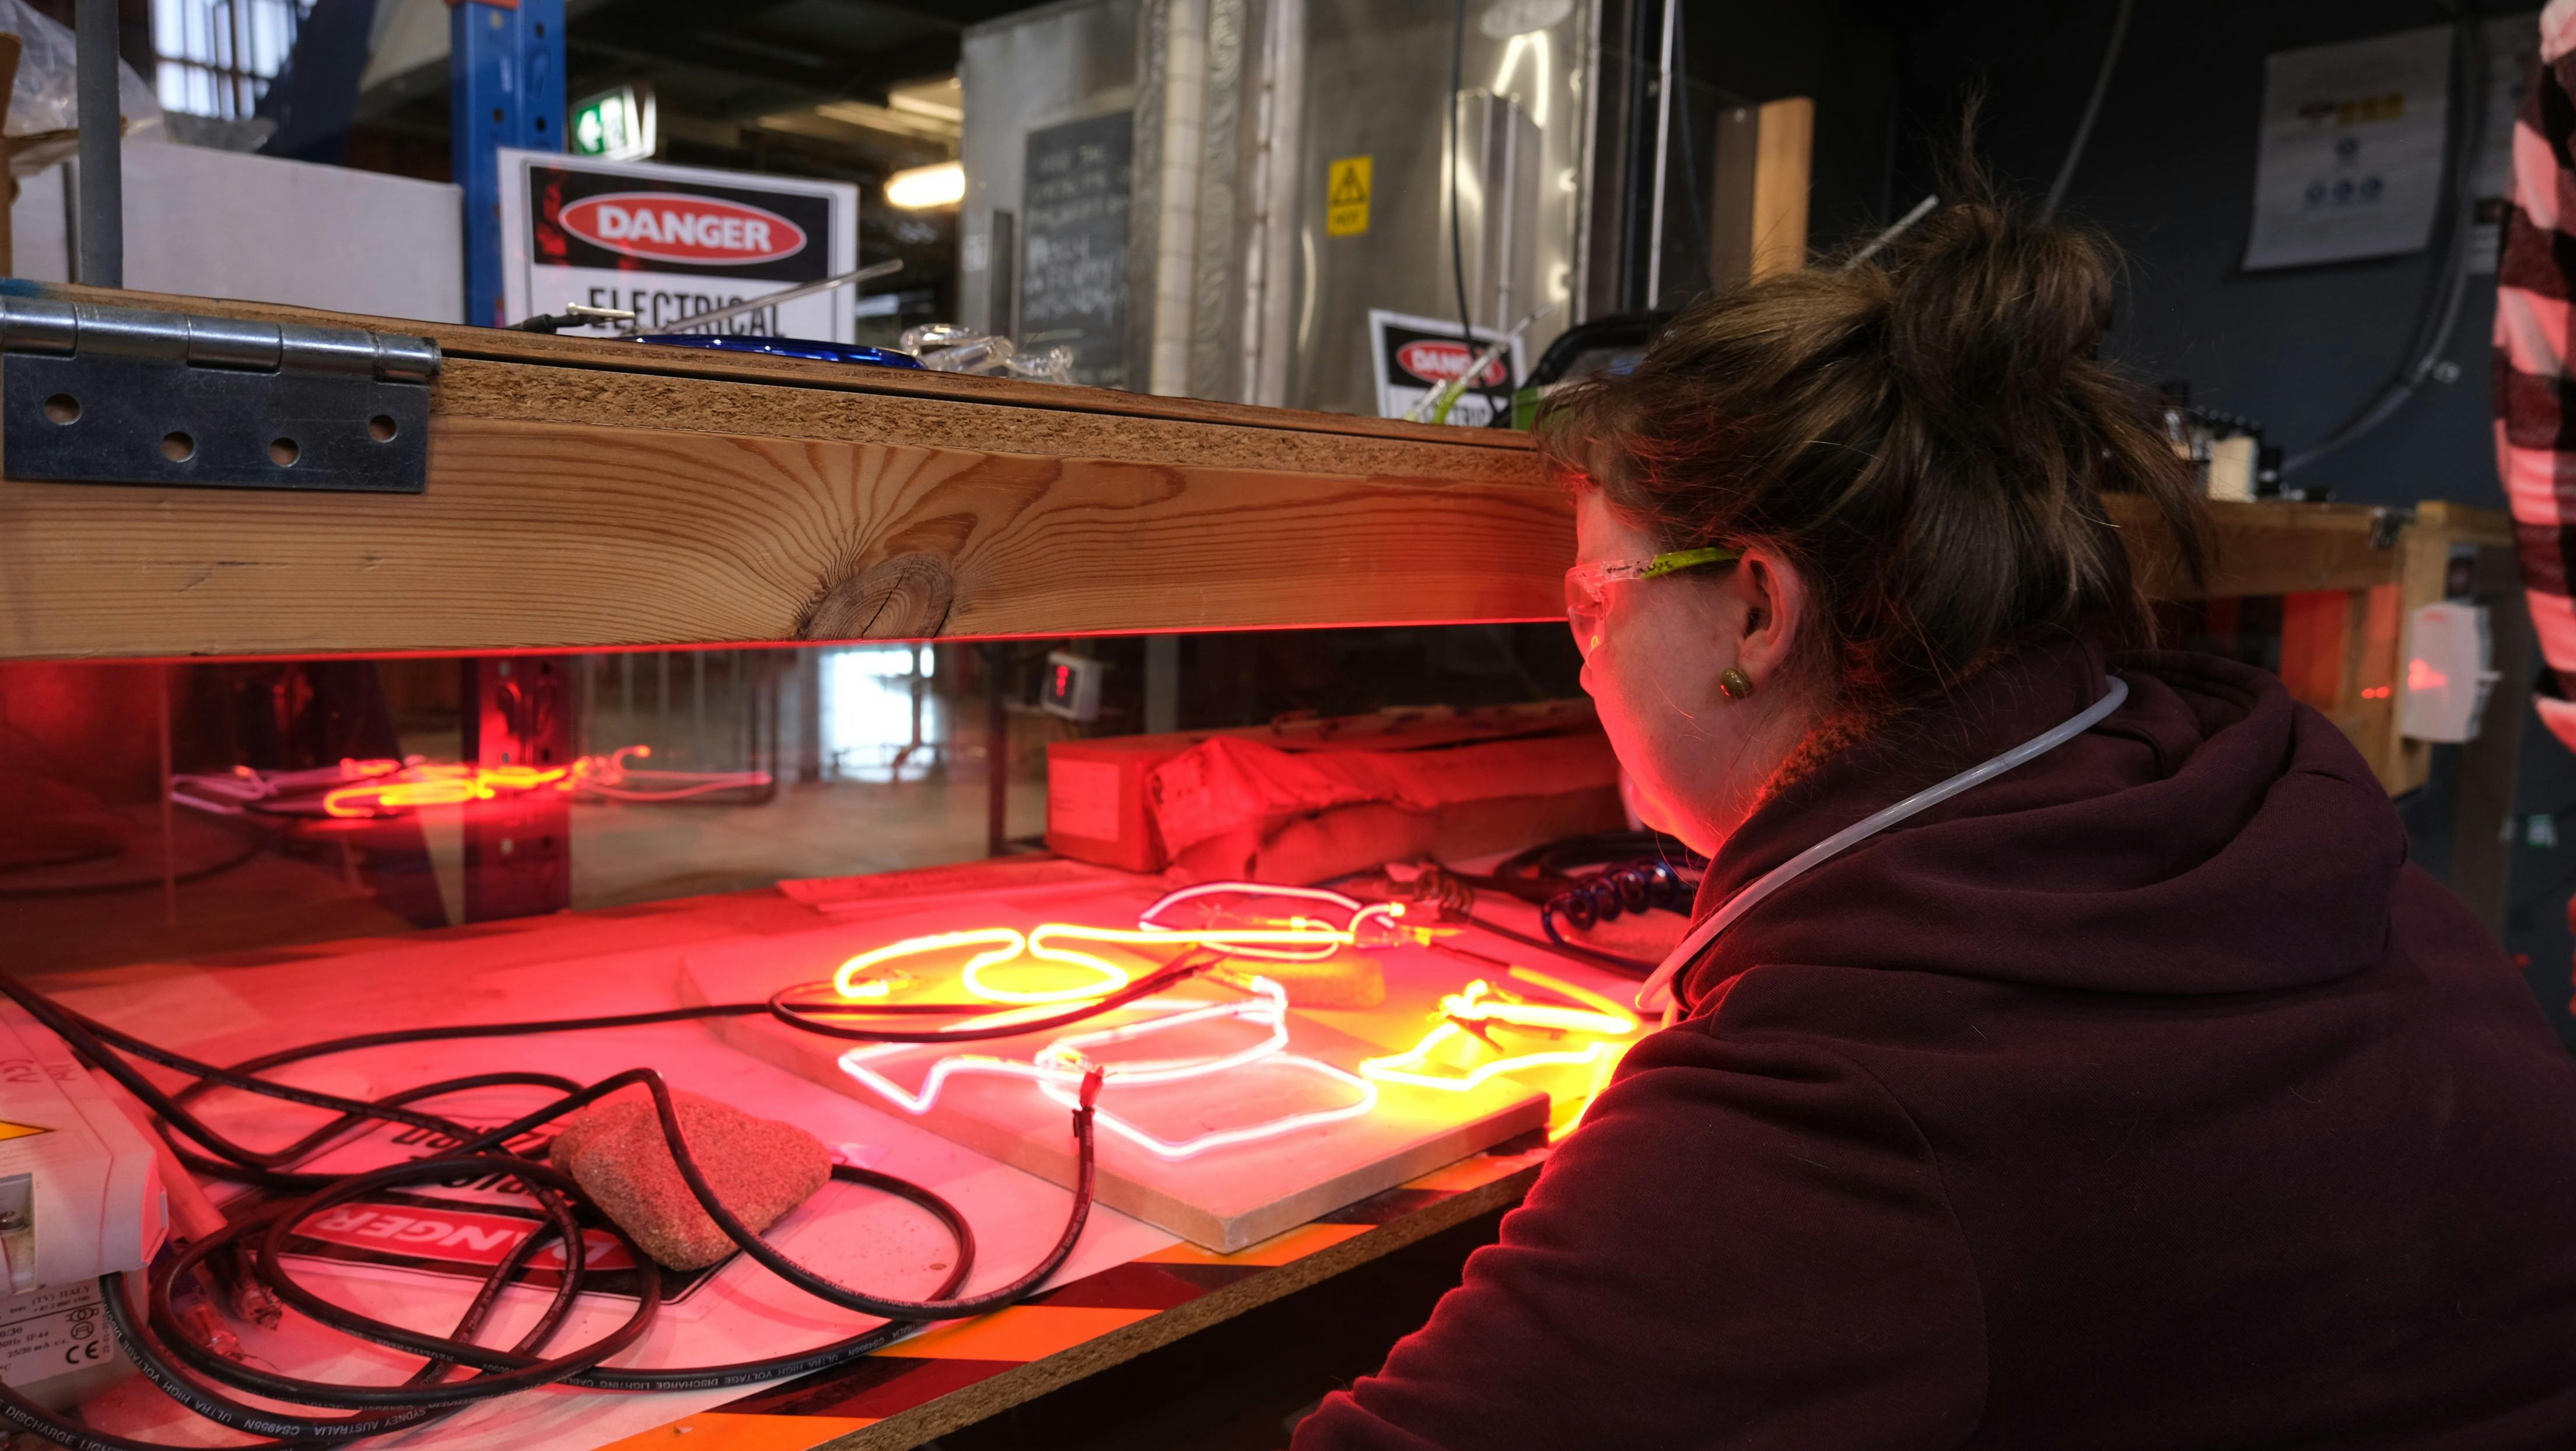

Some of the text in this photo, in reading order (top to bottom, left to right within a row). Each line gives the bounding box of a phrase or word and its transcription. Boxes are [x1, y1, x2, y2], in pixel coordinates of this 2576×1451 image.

[597, 205, 772, 253] DANGER
[589, 288, 786, 338] ELECTRICAL
[1412, 349, 1493, 379] DANG
[316, 1208, 620, 1264] DNGER
[60, 1285, 90, 1298] ITALY
[121, 1340, 160, 1383] VOLTAGE
[777, 1362, 804, 1376] HIGH
[808, 1353, 839, 1368] ULTRA
[600, 1380, 650, 1390] LIGHTING
[655, 1378, 719, 1390] DISCHARGE
[724, 1369, 773, 1386] VOLTAGE
[161, 1380, 191, 1405] HIGH
[194, 1399, 232, 1424] ULTRA
[384, 1407, 426, 1428] SYDNEY
[5, 1405, 76, 1446] DISCHARGE
[243, 1418, 301, 1436] CS4955N
[313, 1419, 380, 1436] AUSTRALIA
